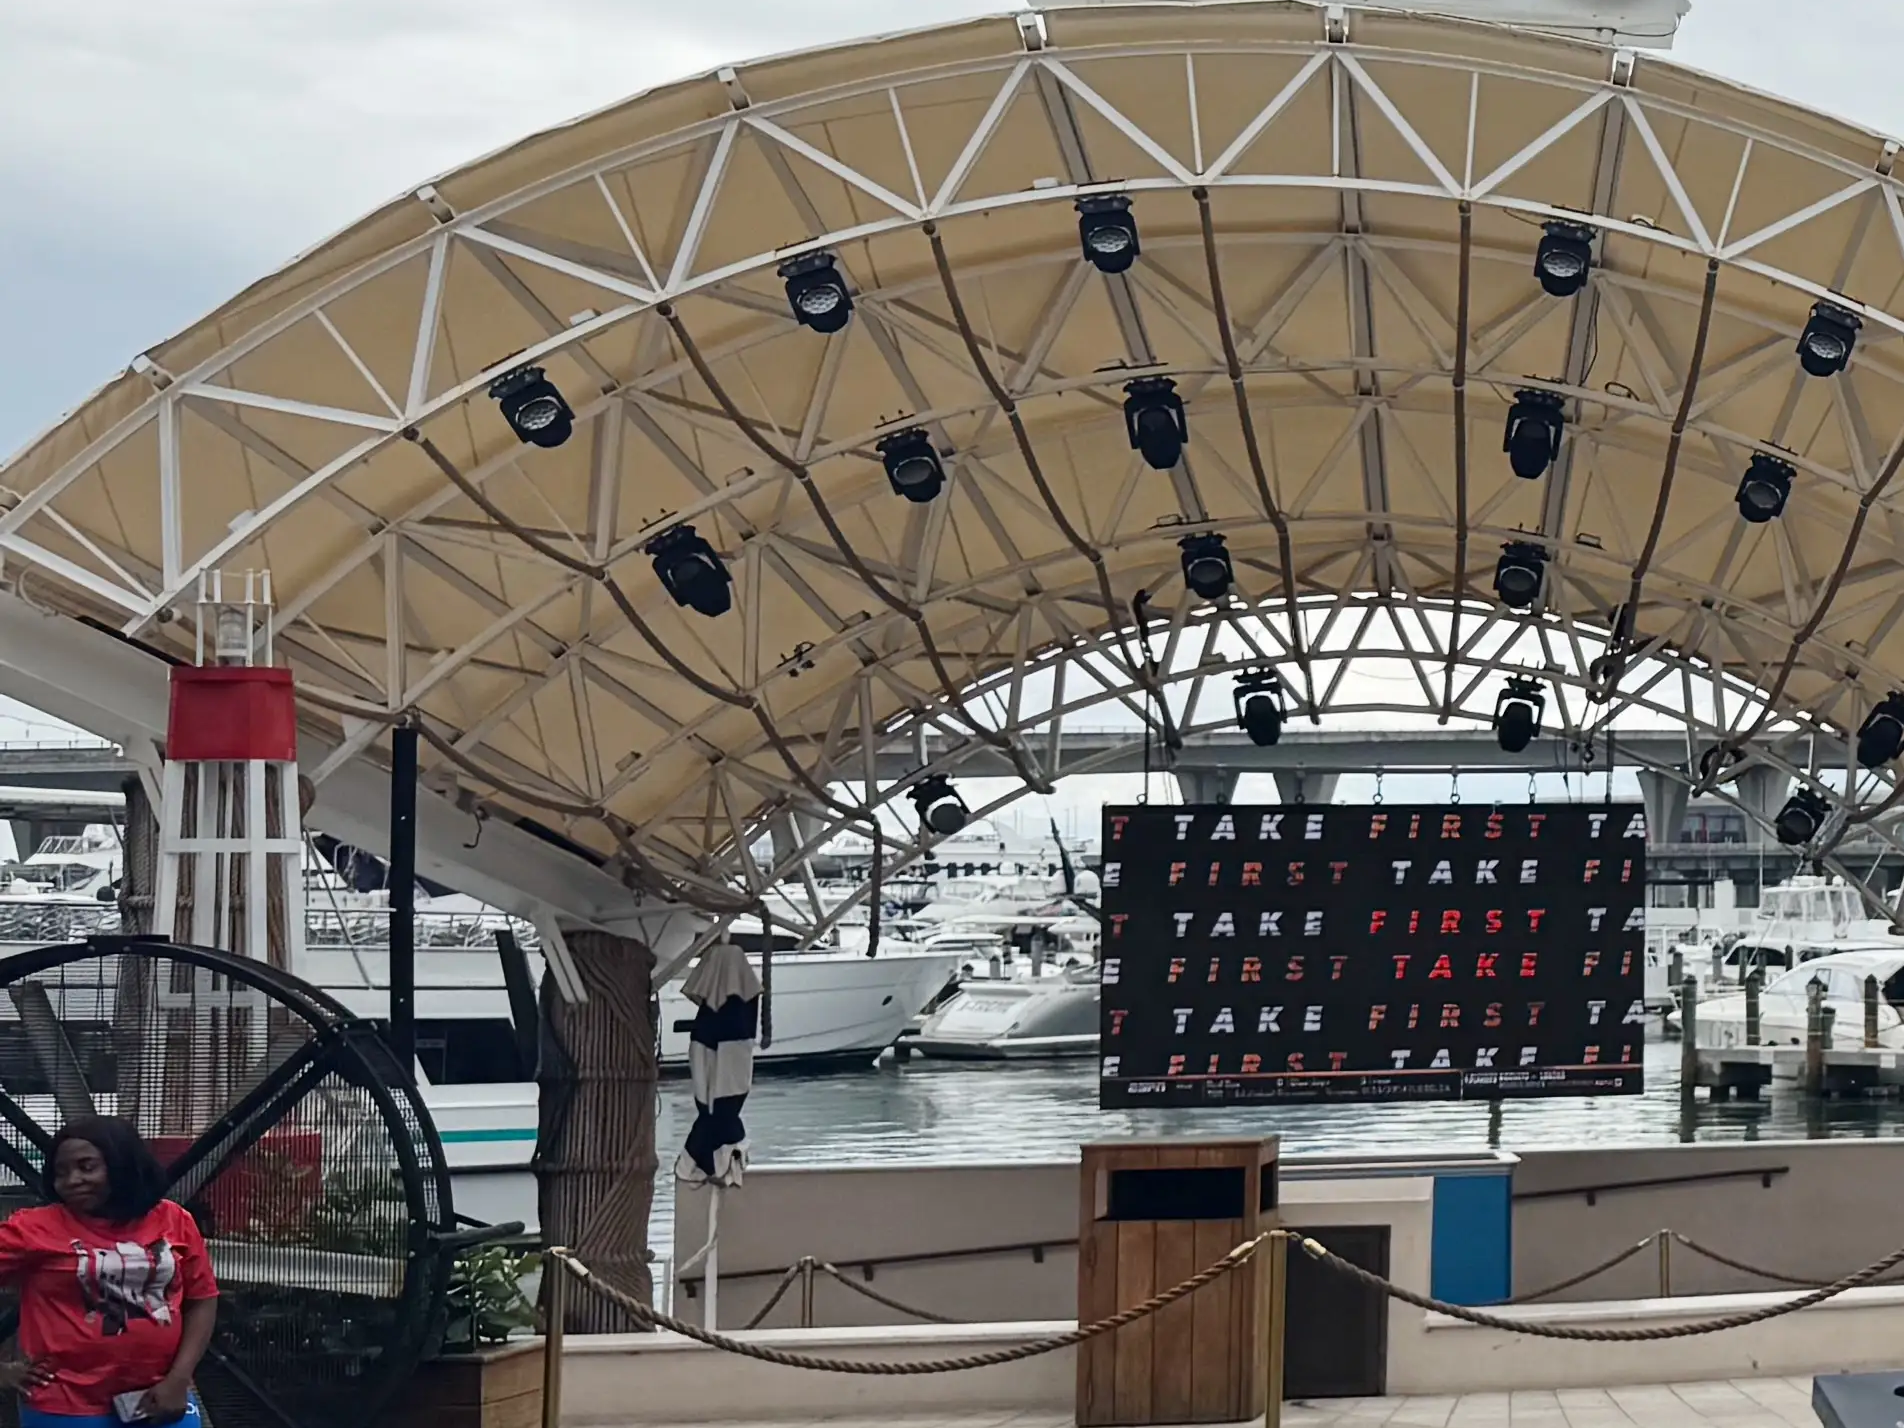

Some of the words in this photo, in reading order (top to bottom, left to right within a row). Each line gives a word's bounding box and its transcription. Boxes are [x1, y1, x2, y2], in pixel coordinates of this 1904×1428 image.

[1174, 814, 1324, 840] TAKE
[1369, 812, 1547, 839] FIRST
[1168, 861, 1348, 886] FIRST
[1391, 859, 1538, 885] TAKE
[1173, 911, 1324, 938] TAKE
[1369, 908, 1546, 935] FIRST
[1167, 955, 1348, 983] FIRST
[1391, 952, 1538, 979] TAKE
[1173, 1005, 1324, 1034] TAKE
[1368, 1002, 1546, 1030] FIRST
[1167, 1051, 1348, 1076] FIRST
[1391, 1046, 1538, 1069] TAKE
